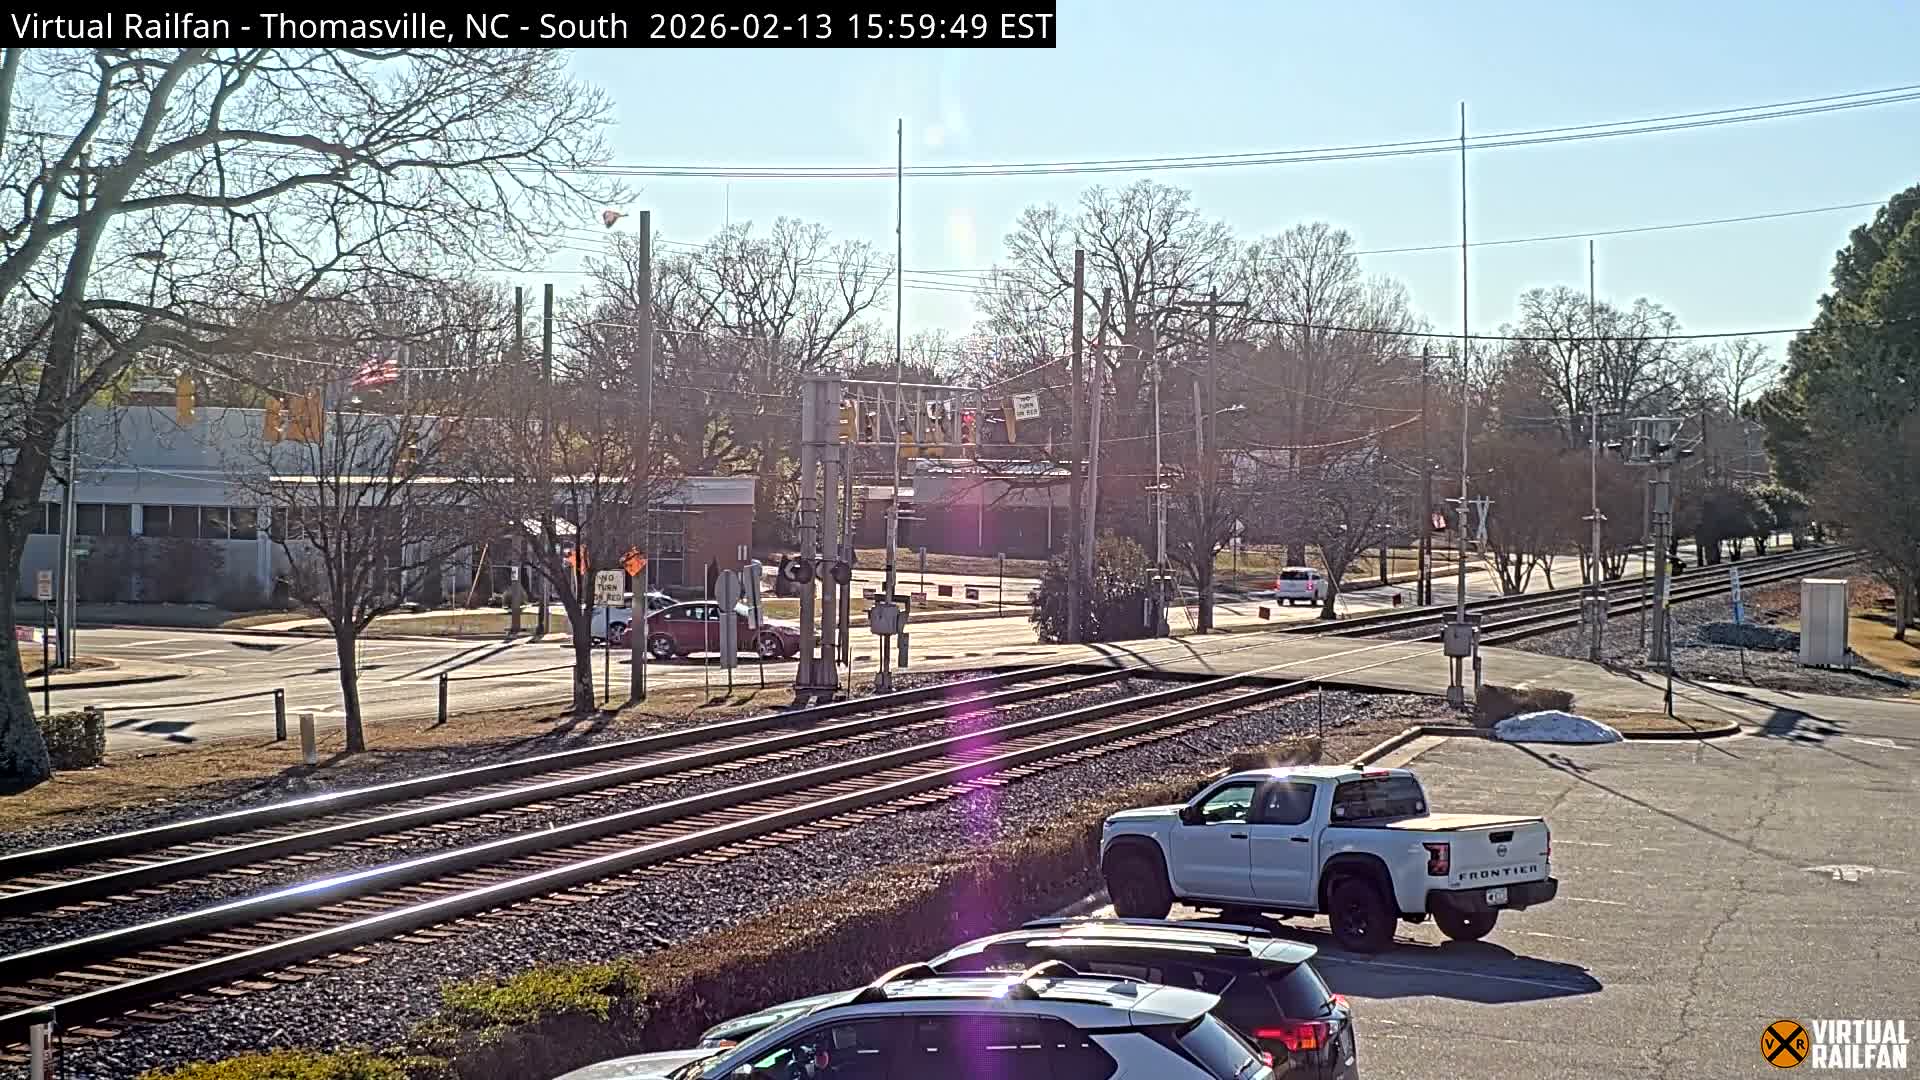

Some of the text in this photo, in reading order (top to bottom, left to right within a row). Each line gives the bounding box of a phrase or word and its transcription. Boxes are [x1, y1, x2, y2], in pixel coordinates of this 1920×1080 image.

[602, 574, 614, 582] NO
[598, 583, 618, 592] TURN
[1458, 864, 1538, 881] FRONTIER
